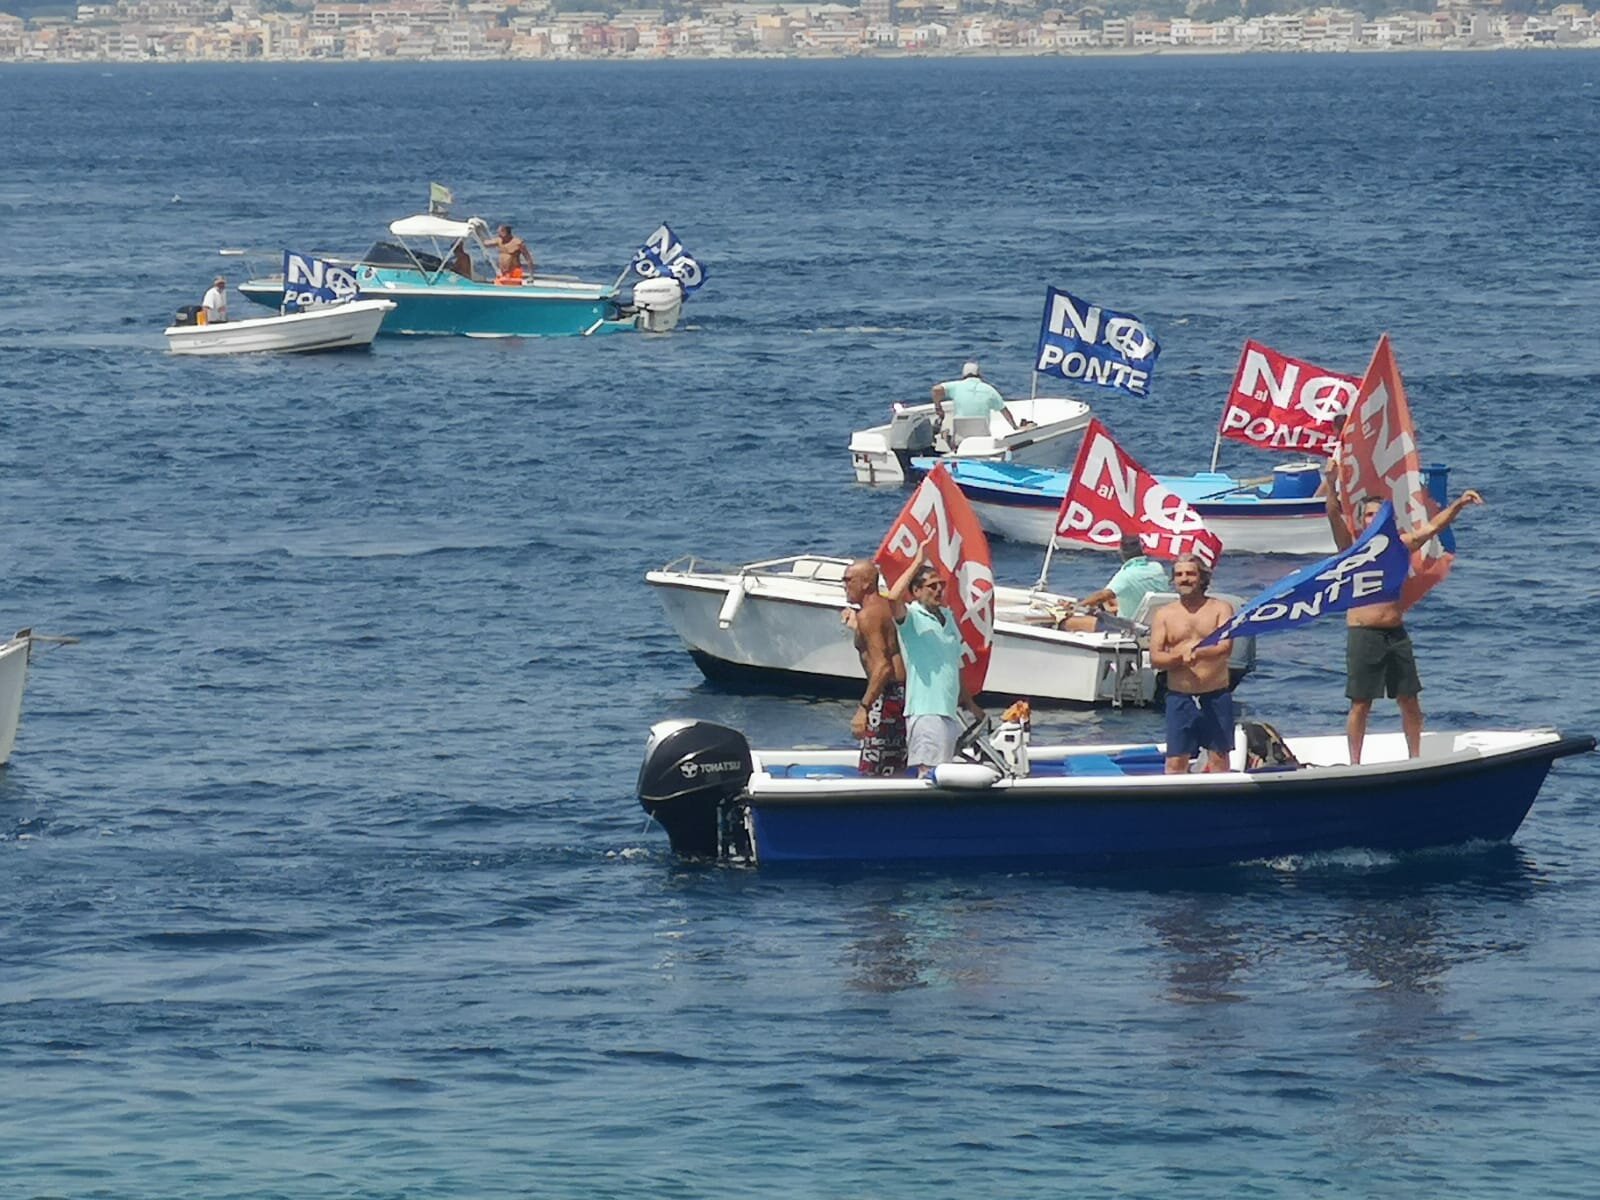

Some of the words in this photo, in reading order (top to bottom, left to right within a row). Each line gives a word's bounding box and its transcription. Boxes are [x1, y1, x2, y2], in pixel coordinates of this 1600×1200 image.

[288, 255, 358, 298] NO
[1048, 294, 1155, 361] NO
[1038, 344, 1148, 395] PONTE
[1238, 349, 1360, 425] NO
[1254, 389, 1268, 402] al
[1080, 433, 1213, 538] NO
[1097, 484, 1114, 500] al
[700, 761, 741, 773] TOHATSU
